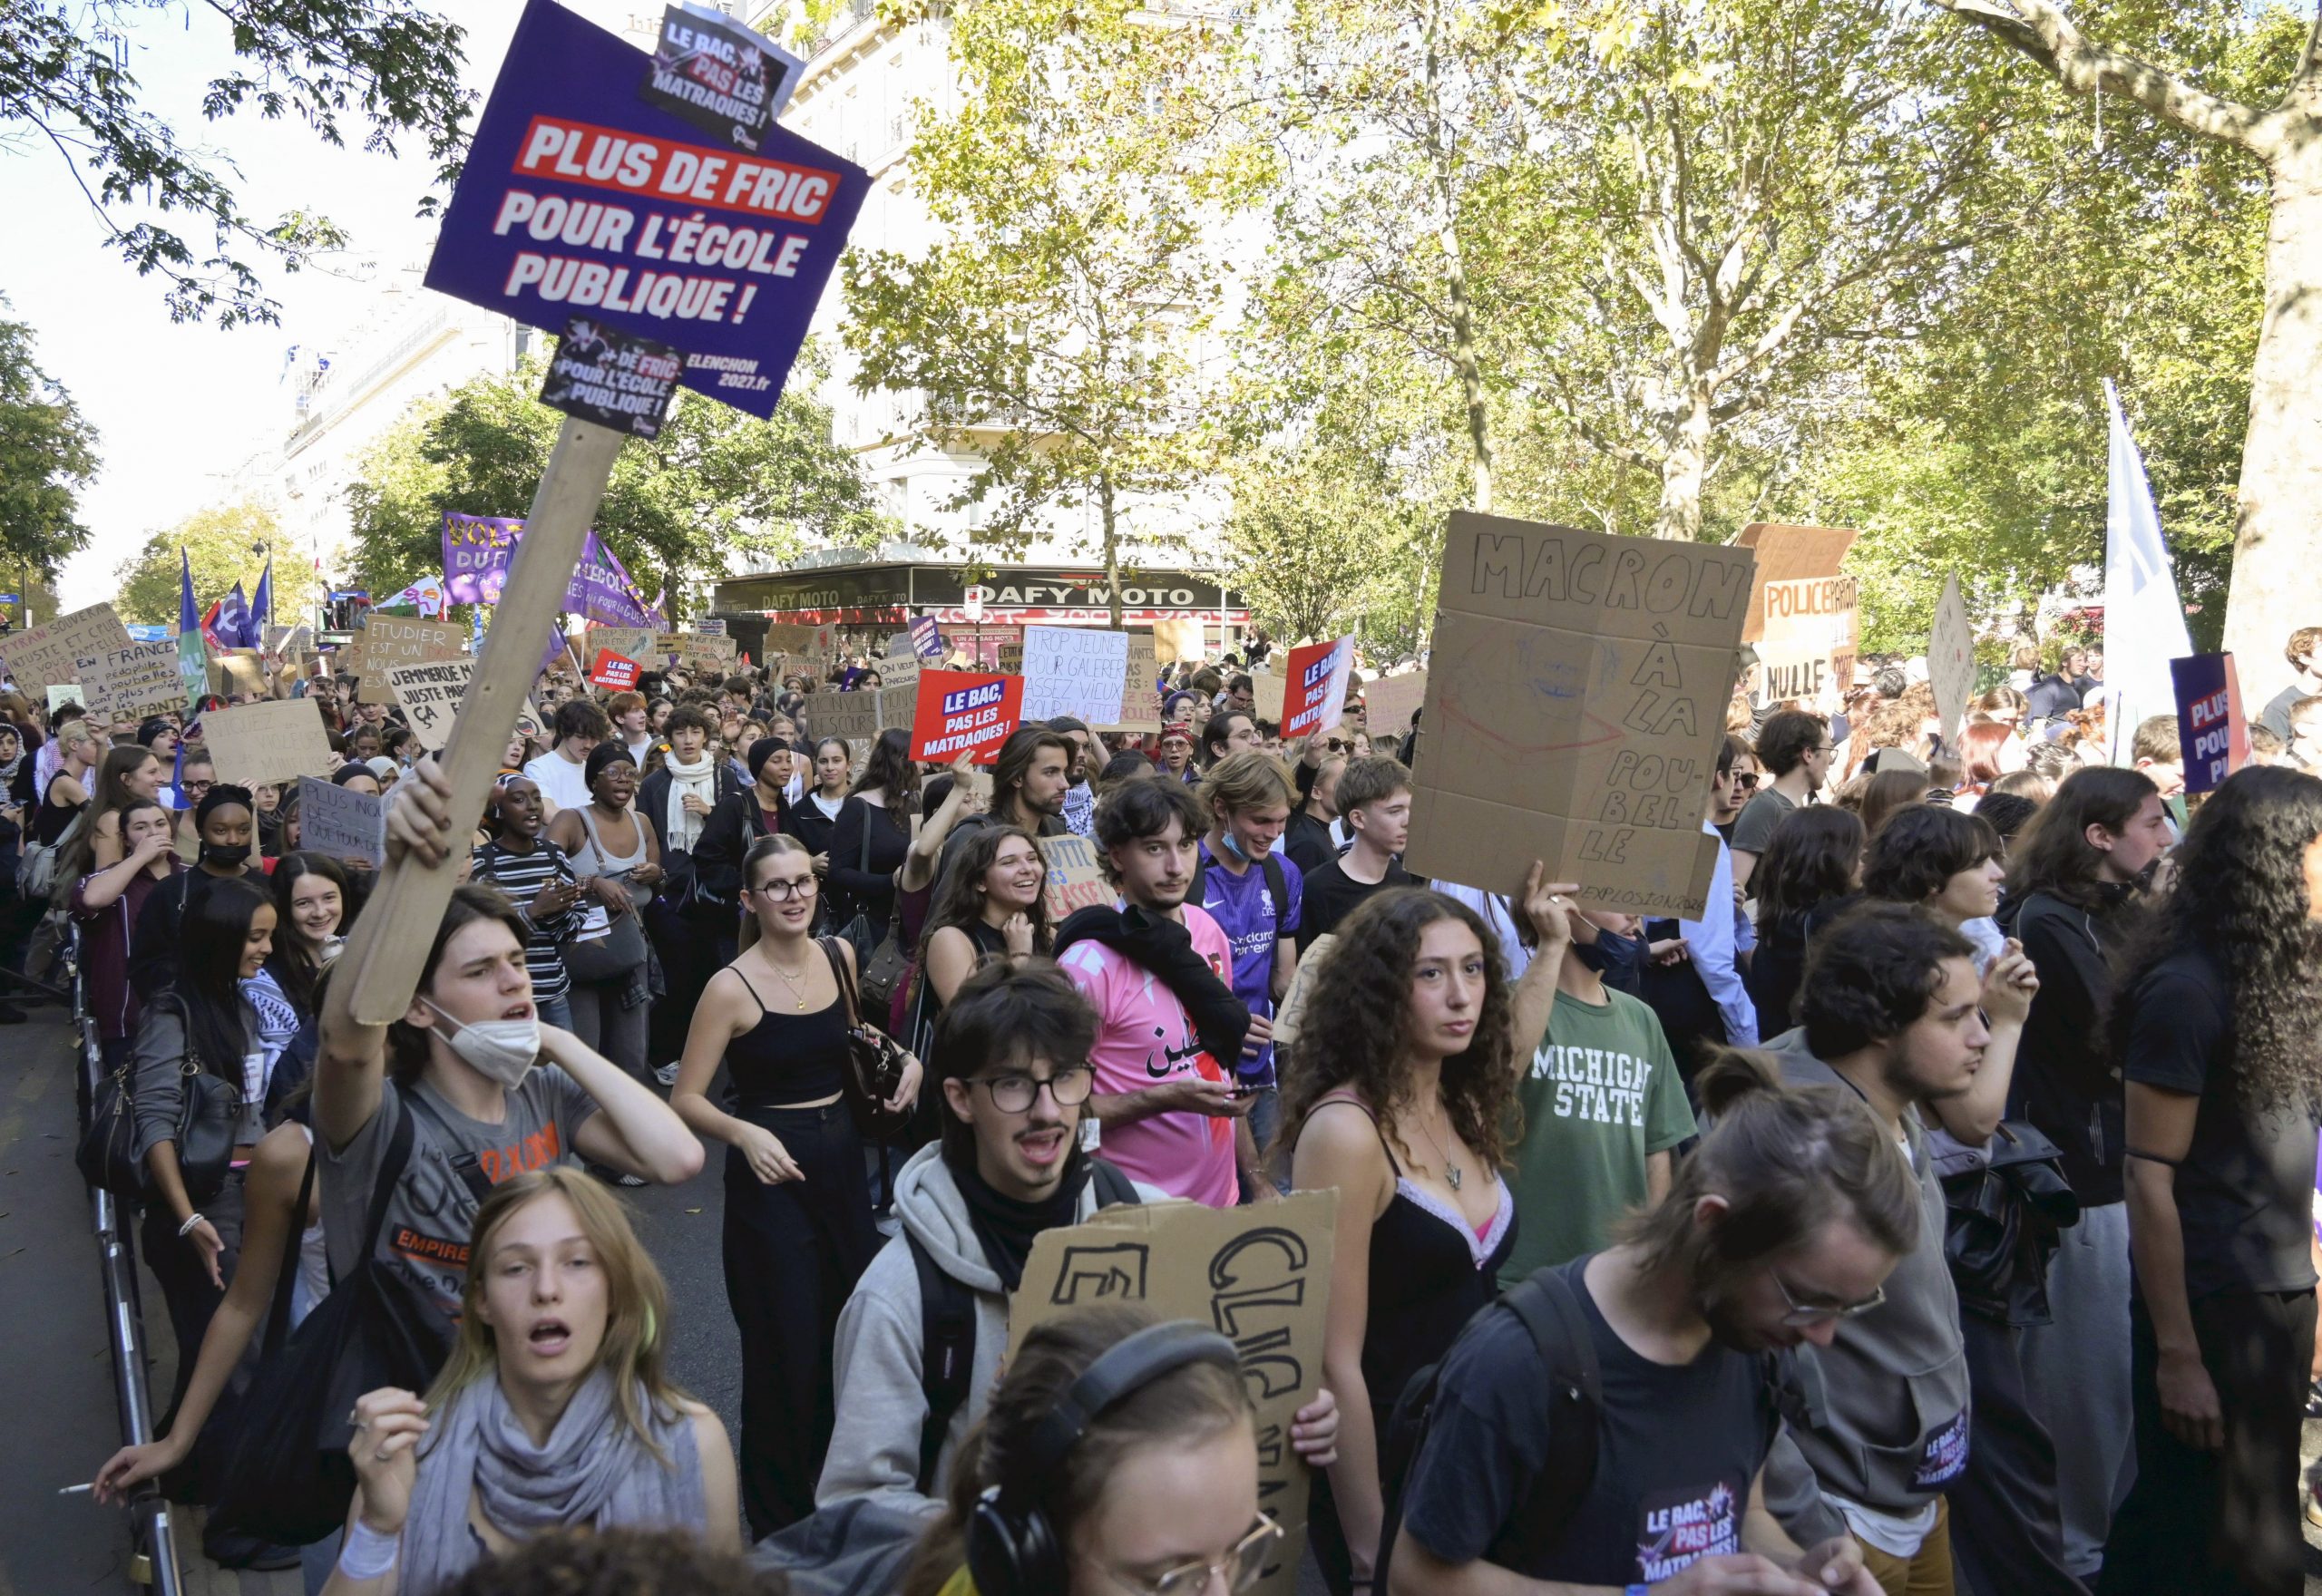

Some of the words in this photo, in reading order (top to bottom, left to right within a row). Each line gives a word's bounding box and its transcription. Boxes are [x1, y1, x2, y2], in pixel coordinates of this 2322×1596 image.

[667, 23, 692, 49] LE
[695, 33, 737, 68] BAC,
[693, 56, 733, 92] PAS
[732, 78, 766, 105] LES
[652, 71, 759, 126] MATRAQUES
[522, 124, 659, 187] PLUS
[659, 151, 726, 200] DE
[725, 170, 828, 217] FRIC
[493, 190, 633, 251] POUR
[637, 213, 809, 277] L'ÉCOLE
[505, 254, 731, 321] PUBLIQUE
[733, 286, 757, 325] !
[618, 351, 639, 367] DE
[638, 356, 679, 379] FRIC
[686, 354, 758, 375] ELENCHON
[559, 362, 605, 386] POUR
[606, 366, 671, 397] L'ÉCOLE
[718, 373, 771, 391] 2027.fr
[570, 383, 655, 415] PUBLIQUE
[1471, 533, 1745, 618] MACRON
[763, 593, 795, 610] DAFY
[799, 590, 839, 608] MOTO
[857, 595, 879, 605] DAFY
[981, 586, 1073, 604] DAFY
[1088, 588, 1195, 605] MOTO
[1767, 581, 1830, 618] POLICE
[372, 622, 446, 646] ETUDIER
[1029, 629, 1069, 653] TROP
[1073, 634, 1127, 654] JEUNES
[8, 644, 60, 670] INJUSTE
[65, 633, 83, 647] ET
[77, 657, 96, 669] EN
[107, 640, 174, 667] FRANCE
[371, 642, 394, 654] EST
[402, 644, 424, 657] UN
[1631, 622, 1683, 688] À
[45, 663, 78, 686] QUE
[80, 674, 95, 685] les
[105, 660, 166, 681] pédophiles
[607, 660, 617, 668] LE
[880, 663, 894, 675] ON
[897, 661, 914, 670] VEUT
[1027, 652, 1063, 676] POUR
[1068, 657, 1126, 679] GALERER
[1304, 664, 1318, 687] LE
[111, 669, 176, 691] poubelles
[1023, 677, 1073, 699] ASSEZ
[1767, 659, 1826, 700] NULLE
[87, 694, 112, 706] sont
[118, 688, 144, 704] plus
[92, 705, 111, 717] que
[117, 698, 134, 710] les
[404, 687, 444, 705] JUSTE
[944, 692, 965, 714] LE
[968, 684, 1001, 707] BAC,
[1305, 684, 1323, 706] PAS
[112, 696, 190, 724] ENFANTS
[414, 706, 438, 729] ÇA
[945, 714, 973, 734] PAS
[975, 707, 998, 725] LES
[1022, 698, 1061, 720] POUR
[1623, 689, 1697, 736] LA
[923, 722, 1004, 756] MATRAQUES
[2195, 725, 2229, 760] POU
[1607, 751, 1702, 792] POU-
[305, 783, 347, 809] PLUS
[307, 803, 342, 827] DES
[1578, 830, 1634, 863] LE
[1049, 870, 1067, 885] ES
[1554, 1082, 1644, 1126] STATE
[397, 1229, 470, 1261] EMPIRE
[1926, 1439, 1938, 1458] LE
[1647, 1509, 1669, 1533] LE
[1675, 1524, 1708, 1551] PAS
[1710, 1515, 1732, 1543] LES
